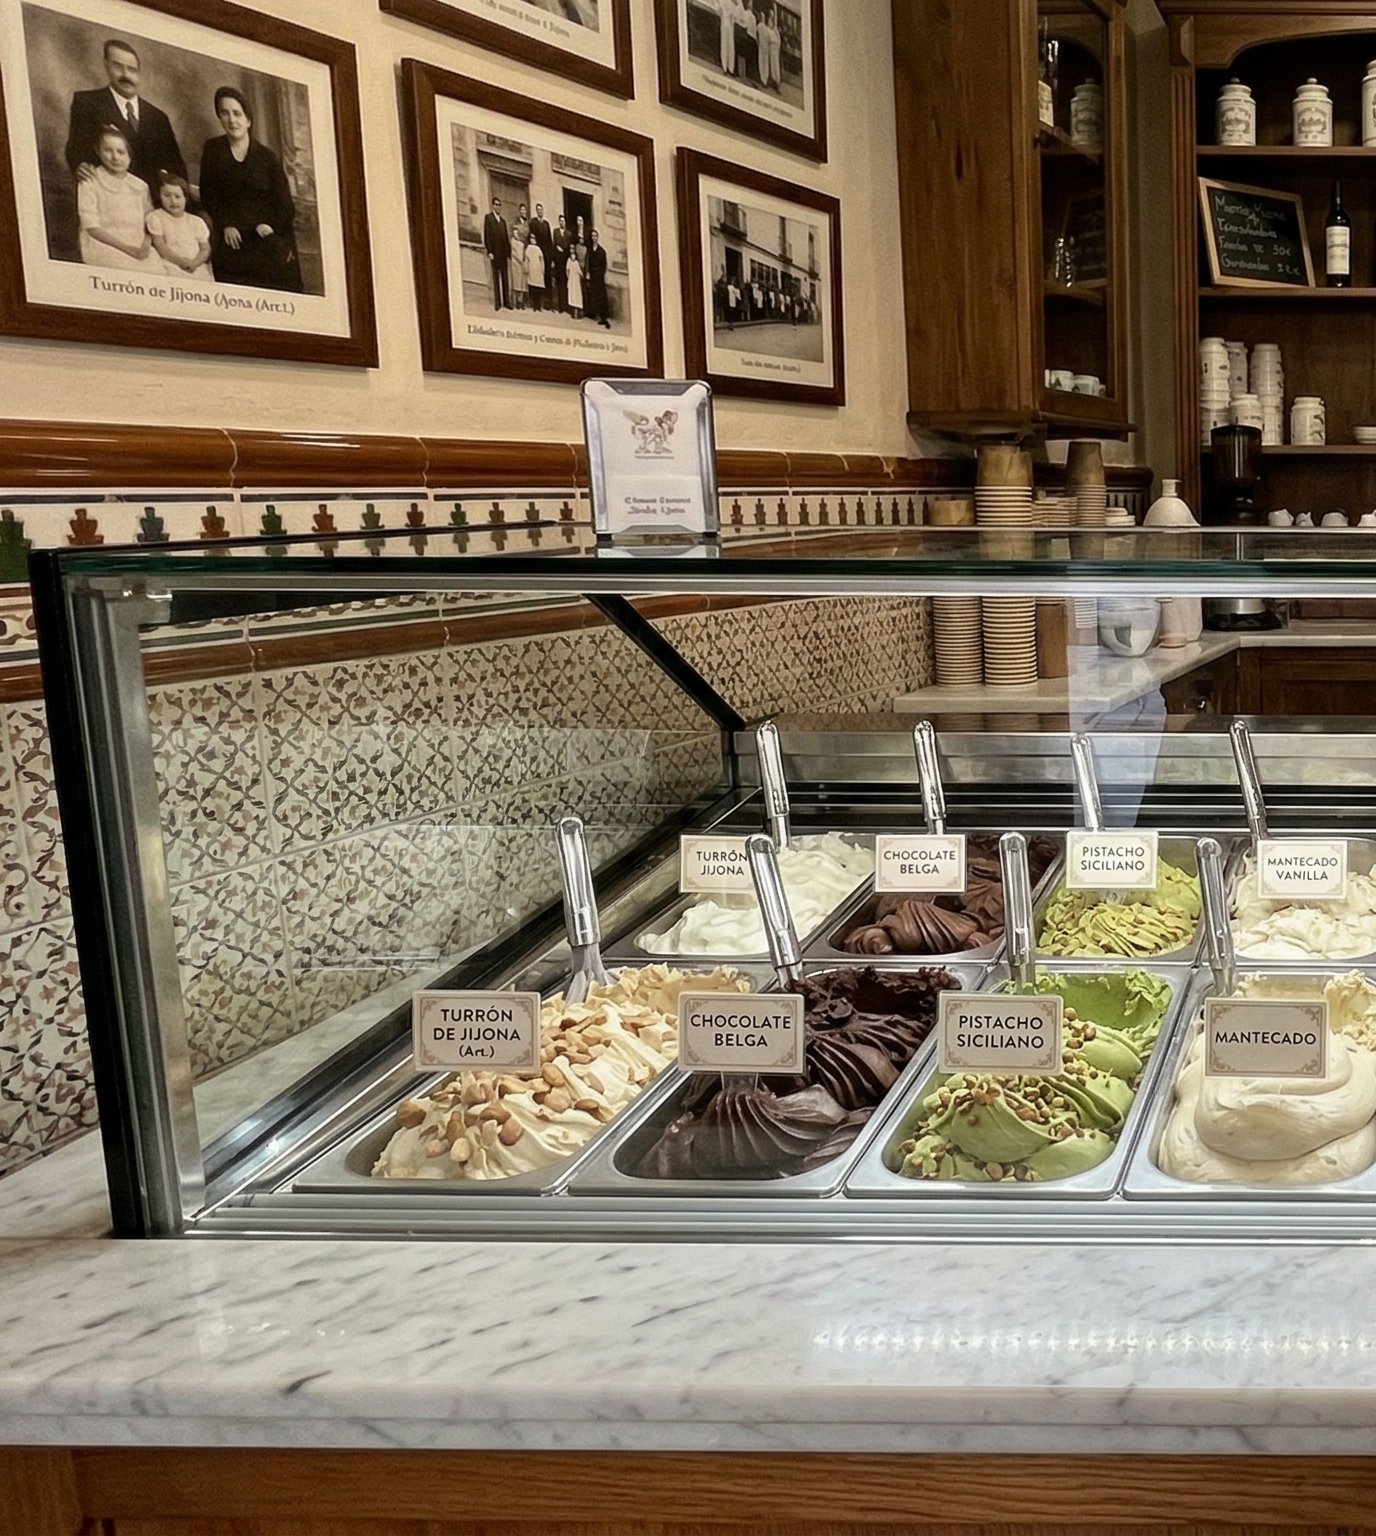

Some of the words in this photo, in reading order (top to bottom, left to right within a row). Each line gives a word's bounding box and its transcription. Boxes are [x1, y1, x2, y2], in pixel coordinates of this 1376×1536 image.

[88, 275, 145, 296] Turrón
[696, 849, 748, 862] TURRÓN
[883, 850, 956, 861] CHOCOLATE
[1082, 846, 1145, 858] PISTACHO
[1080, 859, 1145, 871] SICILIANO
[1267, 856, 1338, 867] MANTECADO
[700, 864, 745, 876] JIJONA
[900, 863, 940, 875] BELGA
[1275, 870, 1329, 881] VANILLA
[440, 1005, 513, 1023] TURRÓN
[690, 1014, 791, 1030] CHOCOLATE
[959, 1015, 1044, 1030] PISTACHO
[433, 1027, 455, 1041] DE
[460, 1027, 521, 1041] JIJONA
[714, 1033, 768, 1047] BELGA
[956, 1033, 1044, 1049] SICILIANO
[1215, 1031, 1317, 1045] MANTECADO
[458, 1044, 495, 1059] (Art.)
